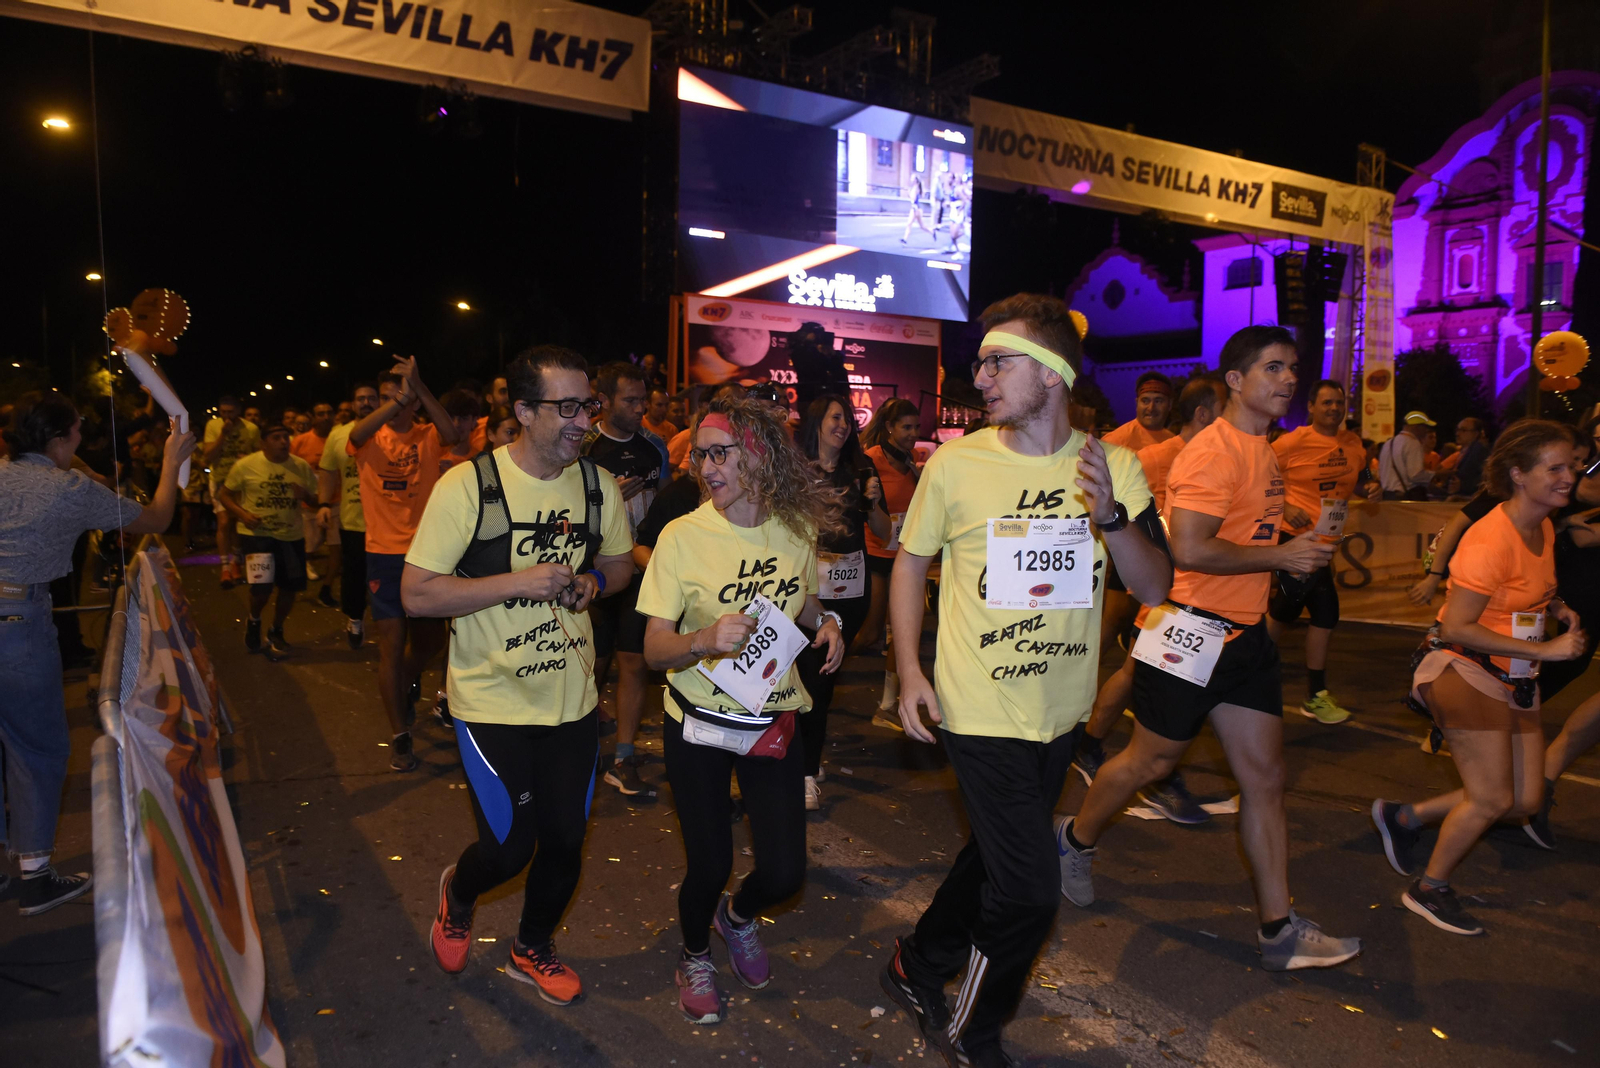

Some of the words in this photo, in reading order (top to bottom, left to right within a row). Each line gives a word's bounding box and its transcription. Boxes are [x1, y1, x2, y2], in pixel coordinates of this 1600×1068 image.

[308, 0, 515, 57] SEVILLA
[977, 125, 1115, 178] NOCTURNA
[1121, 157, 1211, 197] SEVILLA
[1016, 489, 1066, 511] LAS
[738, 557, 777, 579] LAS
[1013, 550, 1075, 571] 12985
[827, 568, 858, 581] 15022
[717, 576, 799, 604] CHICAS
[505, 618, 561, 652] BEATRIZ
[980, 614, 1046, 649] BEATRIZ
[1163, 625, 1205, 654] 4552
[733, 626, 778, 675] 12989
[1014, 639, 1089, 656] CAYETANA
[515, 658, 566, 678] CHARO
[991, 661, 1048, 680] CHARO
